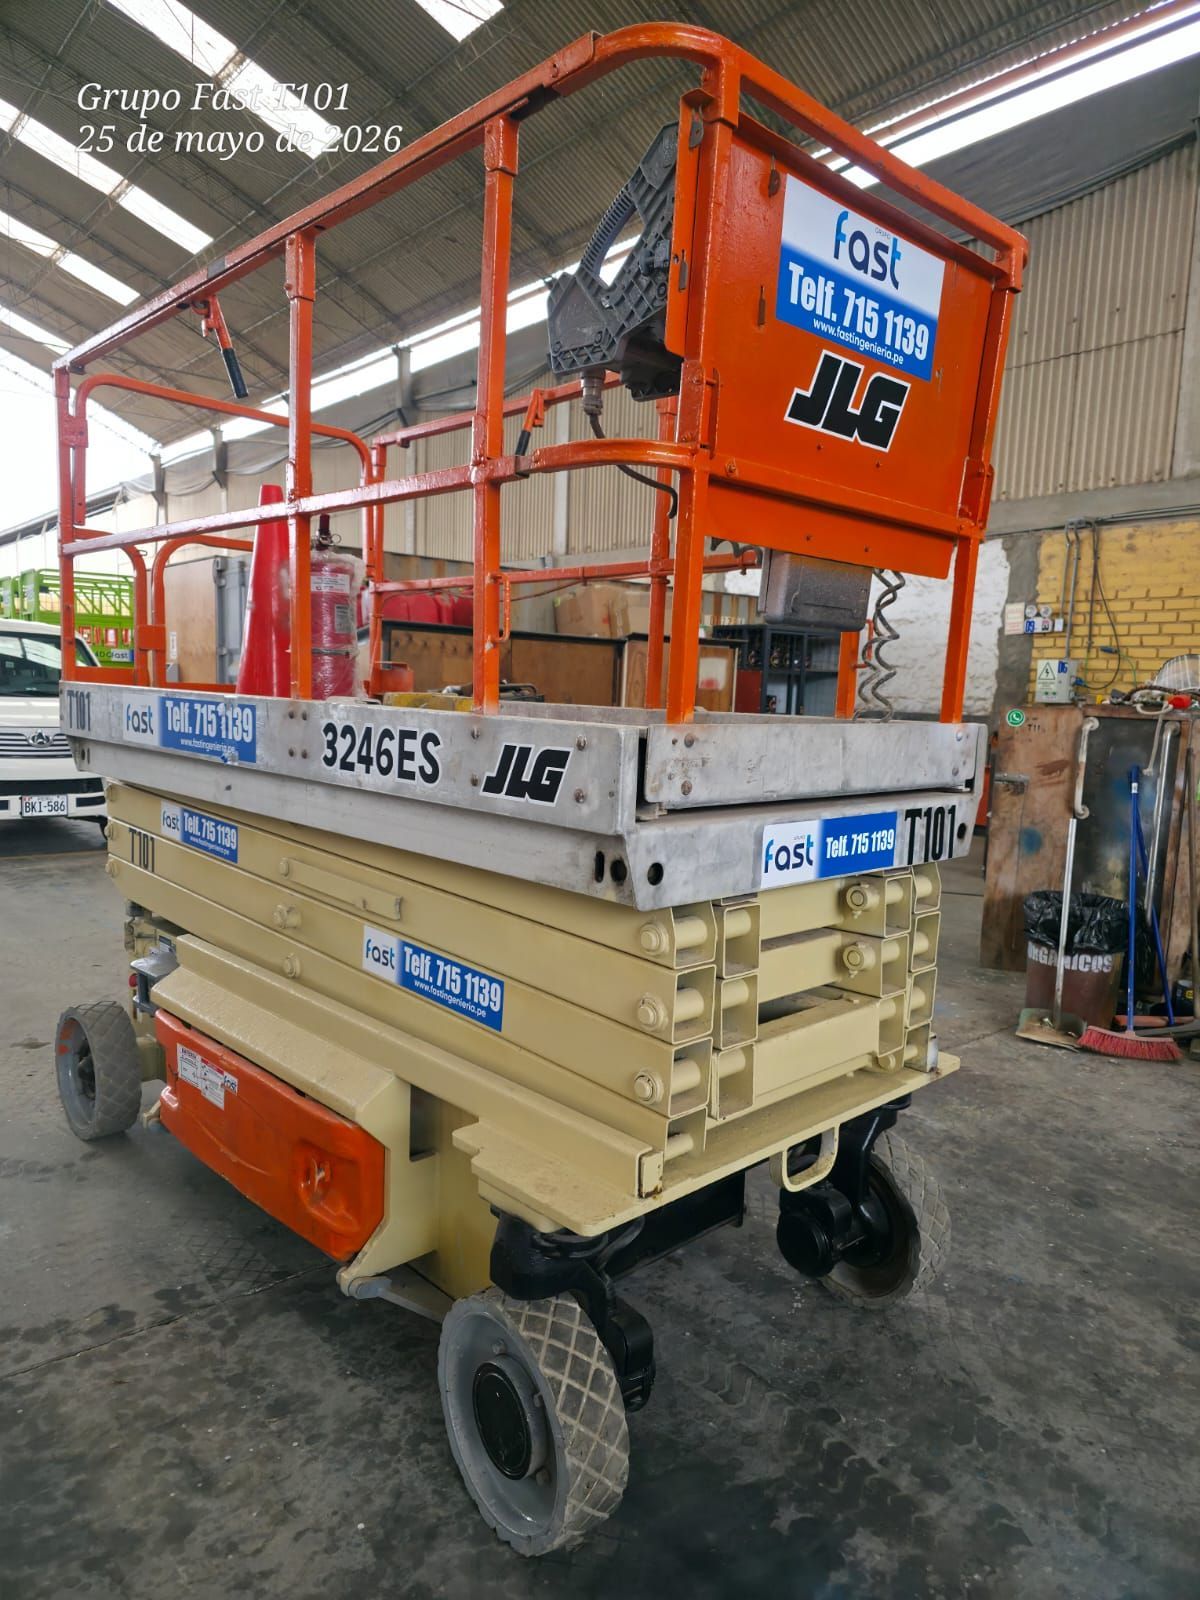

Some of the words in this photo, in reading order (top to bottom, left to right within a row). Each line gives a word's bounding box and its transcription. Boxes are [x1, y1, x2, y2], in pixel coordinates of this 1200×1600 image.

[833, 210, 902, 290] fast
[788, 261, 837, 323] Telf.
[842, 287, 880, 339] 715
[883, 309, 930, 361] 1139
[813, 317, 904, 365] www.fastingenieria.pe
[784, 350, 911, 452] JLG
[66, 689, 92, 732] T101
[126, 703, 154, 735] fast
[165, 700, 192, 734] Telf.
[194, 703, 217, 738] 715
[217, 703, 253, 743] 1139
[322, 722, 441, 784] 3246ES
[481, 744, 572, 804] JLG
[24, 800, 66, 814] BKI-586
[162, 810, 180, 832] fast
[128, 827, 155, 873] T101
[201, 818, 217, 842] 715
[217, 825, 237, 850] 1139
[763, 834, 814, 874] fast
[826, 836, 849, 859] Telf.
[851, 832, 870, 856] 715
[870, 829, 895, 852] 1139
[904, 805, 957, 865] T101
[366, 938, 395, 970] fast
[404, 946, 433, 983] Telf.
[436, 959, 461, 995] 715
[464, 972, 502, 1012] 1139
[413, 979, 487, 1018] www.fastingenieria.pe
